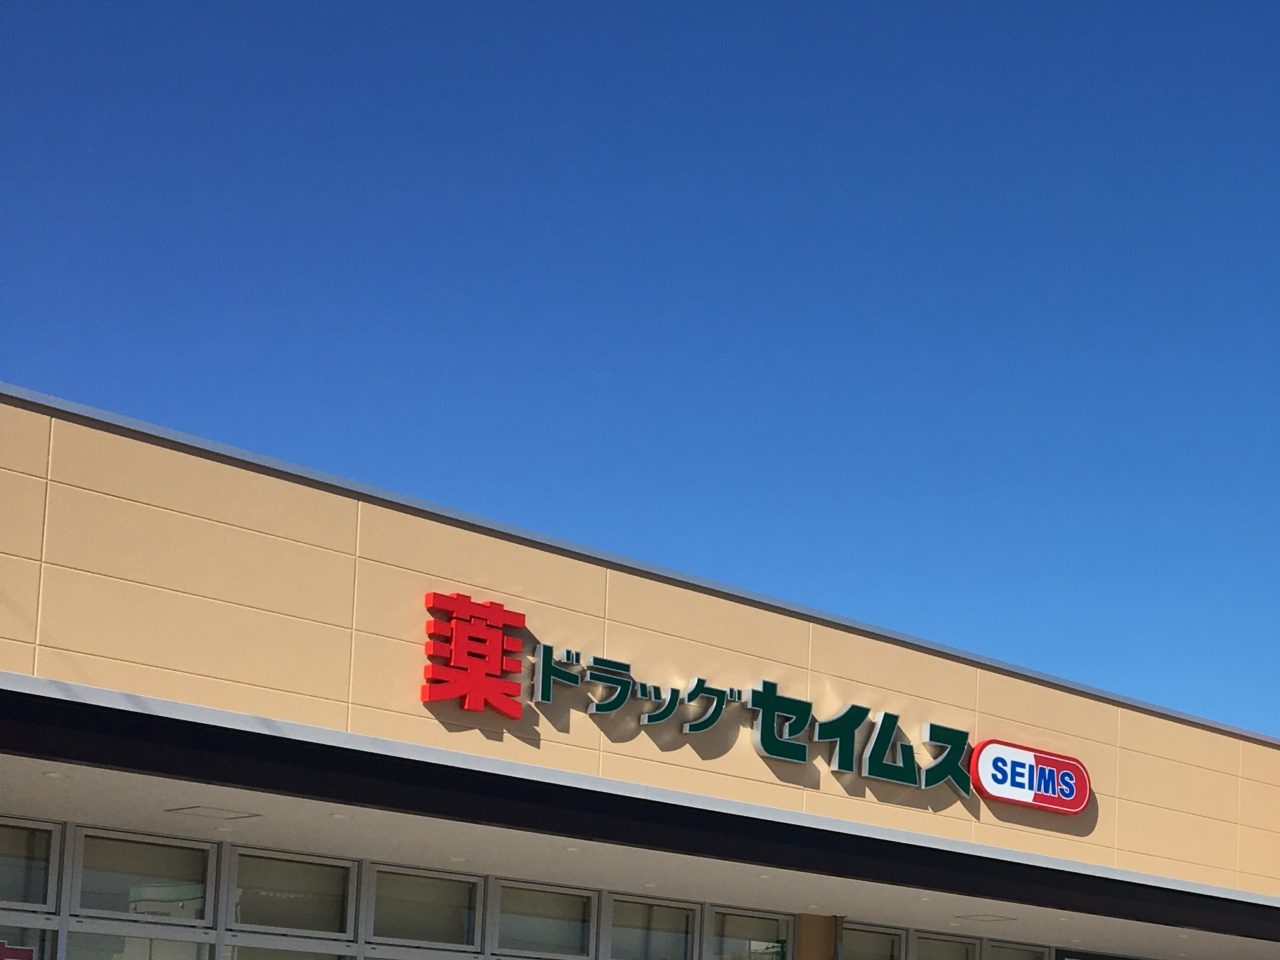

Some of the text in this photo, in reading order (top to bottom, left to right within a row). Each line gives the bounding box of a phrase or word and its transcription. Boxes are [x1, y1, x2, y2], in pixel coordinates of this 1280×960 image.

[421, 591, 1076, 800] 薬 ドラッグセイムス SEIMS
